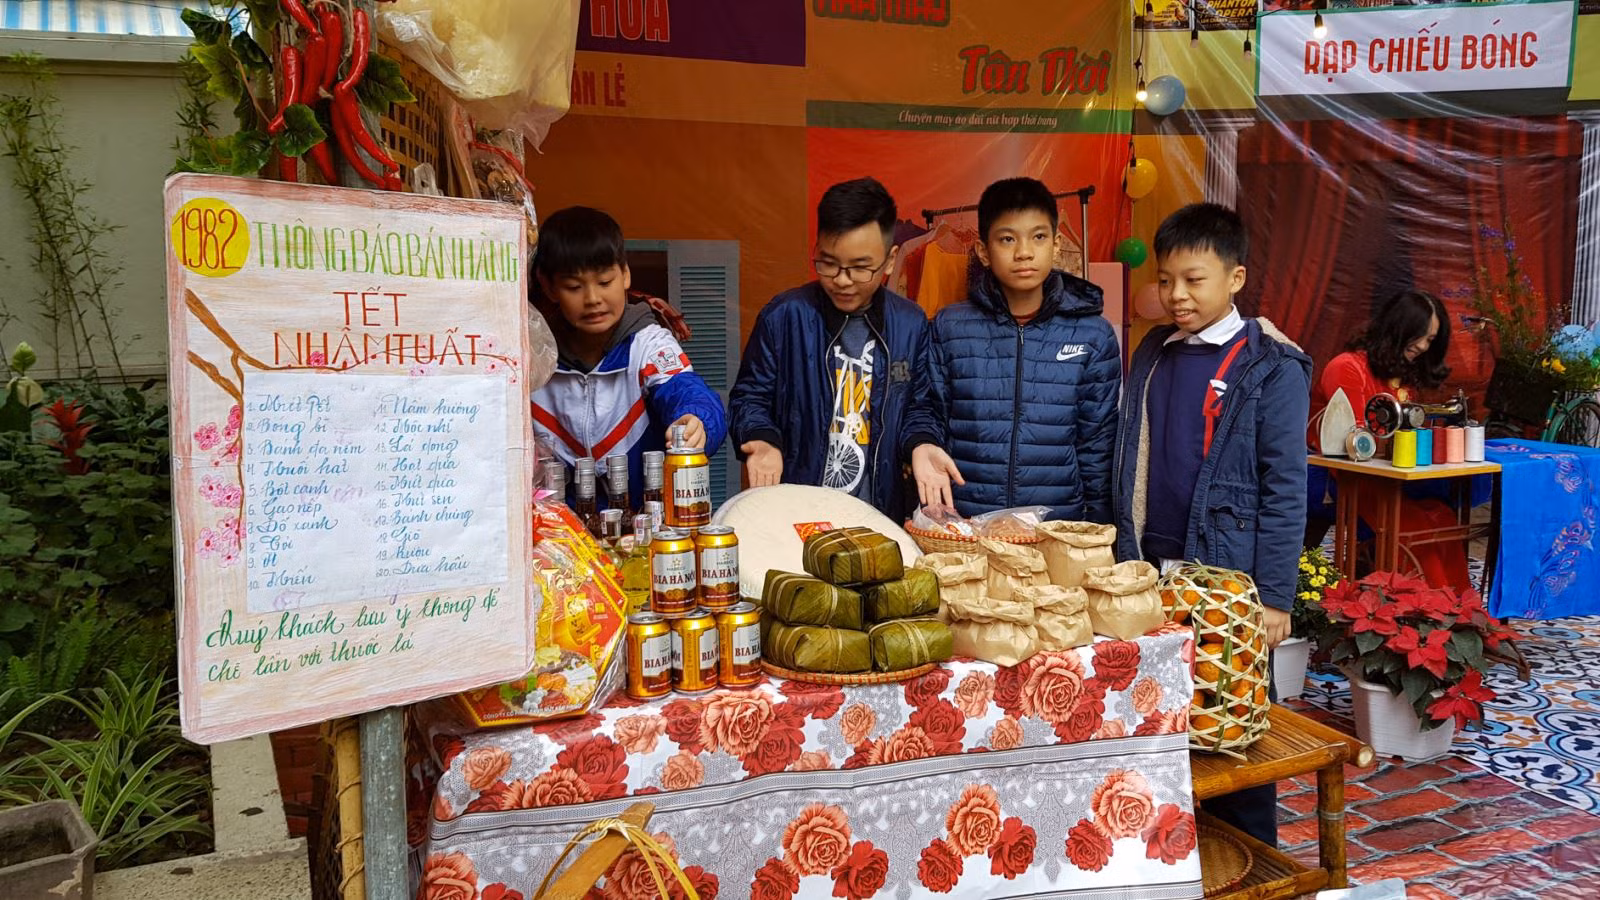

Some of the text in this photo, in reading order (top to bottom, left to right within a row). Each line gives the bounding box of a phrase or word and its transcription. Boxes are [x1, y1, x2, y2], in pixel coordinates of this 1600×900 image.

[1304, 18, 1538, 83] RẠP CHIẾU BÓNG
[960, 45, 1112, 95] Tân Thời
[173, 207, 242, 270] 1982
[252, 218, 519, 283] THÔNG BÁO BÁN HÀNG
[332, 285, 408, 327] TẾT
[273, 326, 482, 367] NHÂM TUẤT
[1062, 344, 1085, 354] NIKE
[675, 488, 692, 499] BIA
[653, 574, 668, 585] BIA
[702, 568, 718, 579] BIA
[271, 610, 345, 641] khách
[416, 595, 477, 623] không
[644, 658, 661, 669] BIA
[701, 650, 715, 662] BIA
[734, 646, 751, 657] BIA
